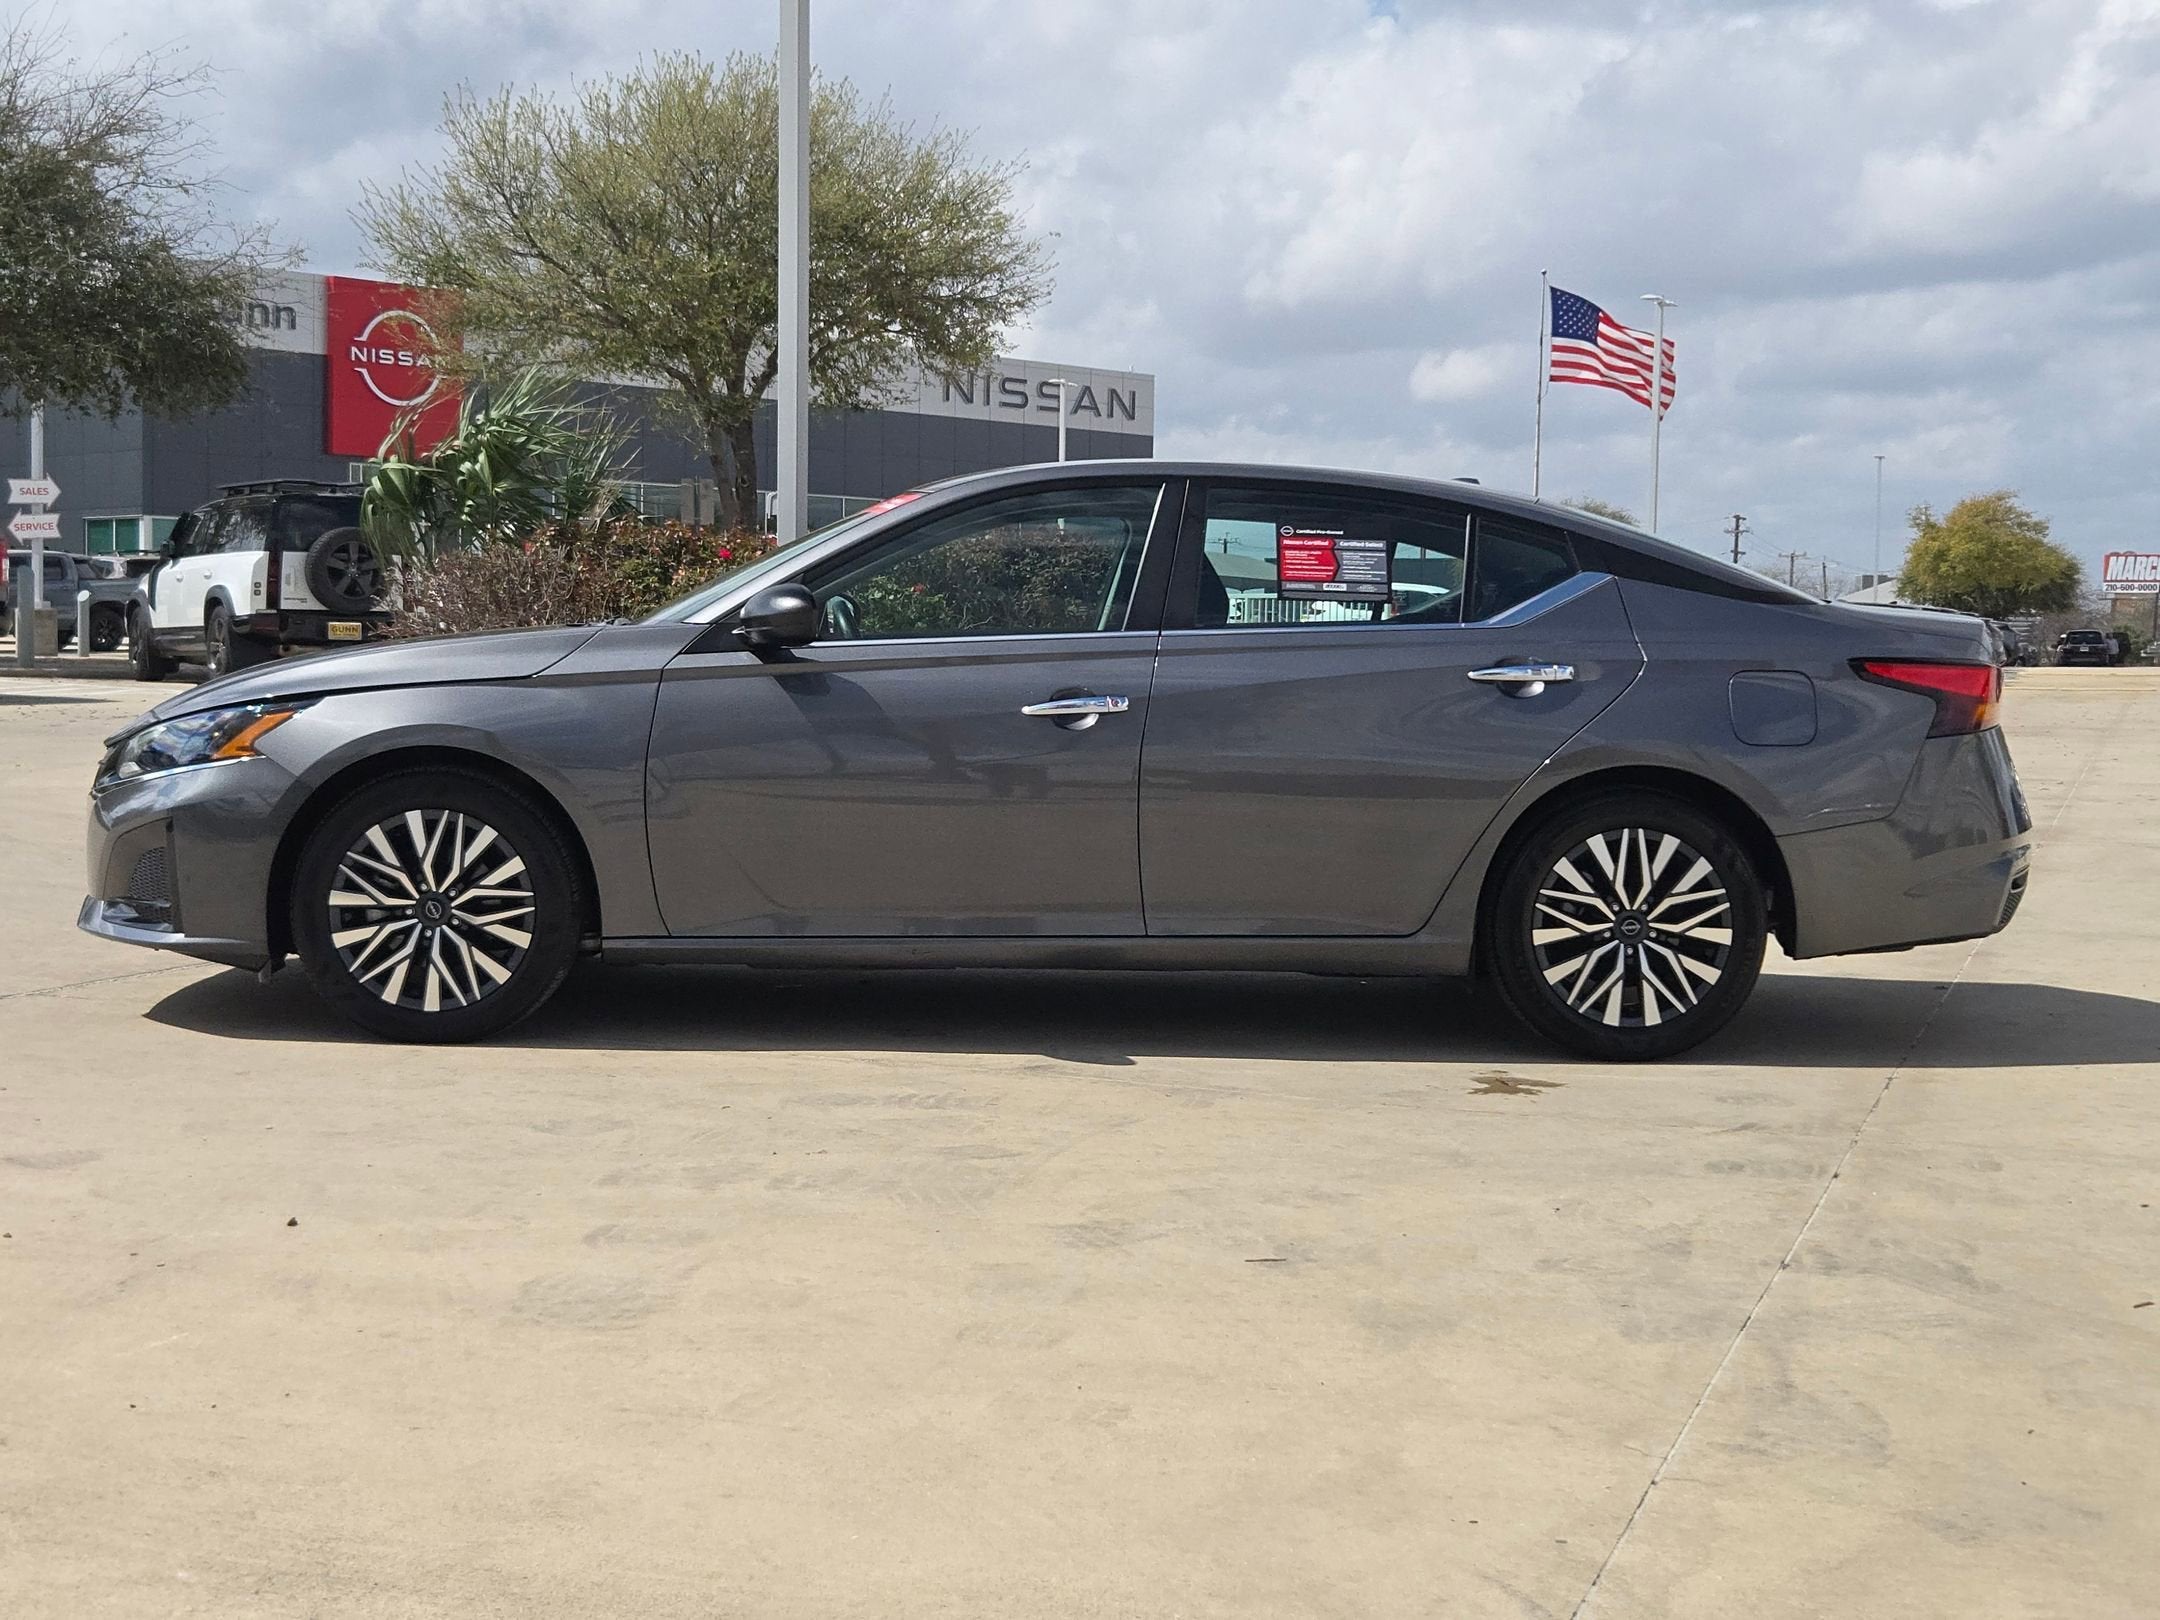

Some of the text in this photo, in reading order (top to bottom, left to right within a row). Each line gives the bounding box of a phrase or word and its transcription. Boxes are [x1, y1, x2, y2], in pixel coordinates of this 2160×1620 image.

[19, 487, 49, 496] SALES
[14, 522, 55, 532] SERVICE
[2106, 556, 2160, 581] MARC
